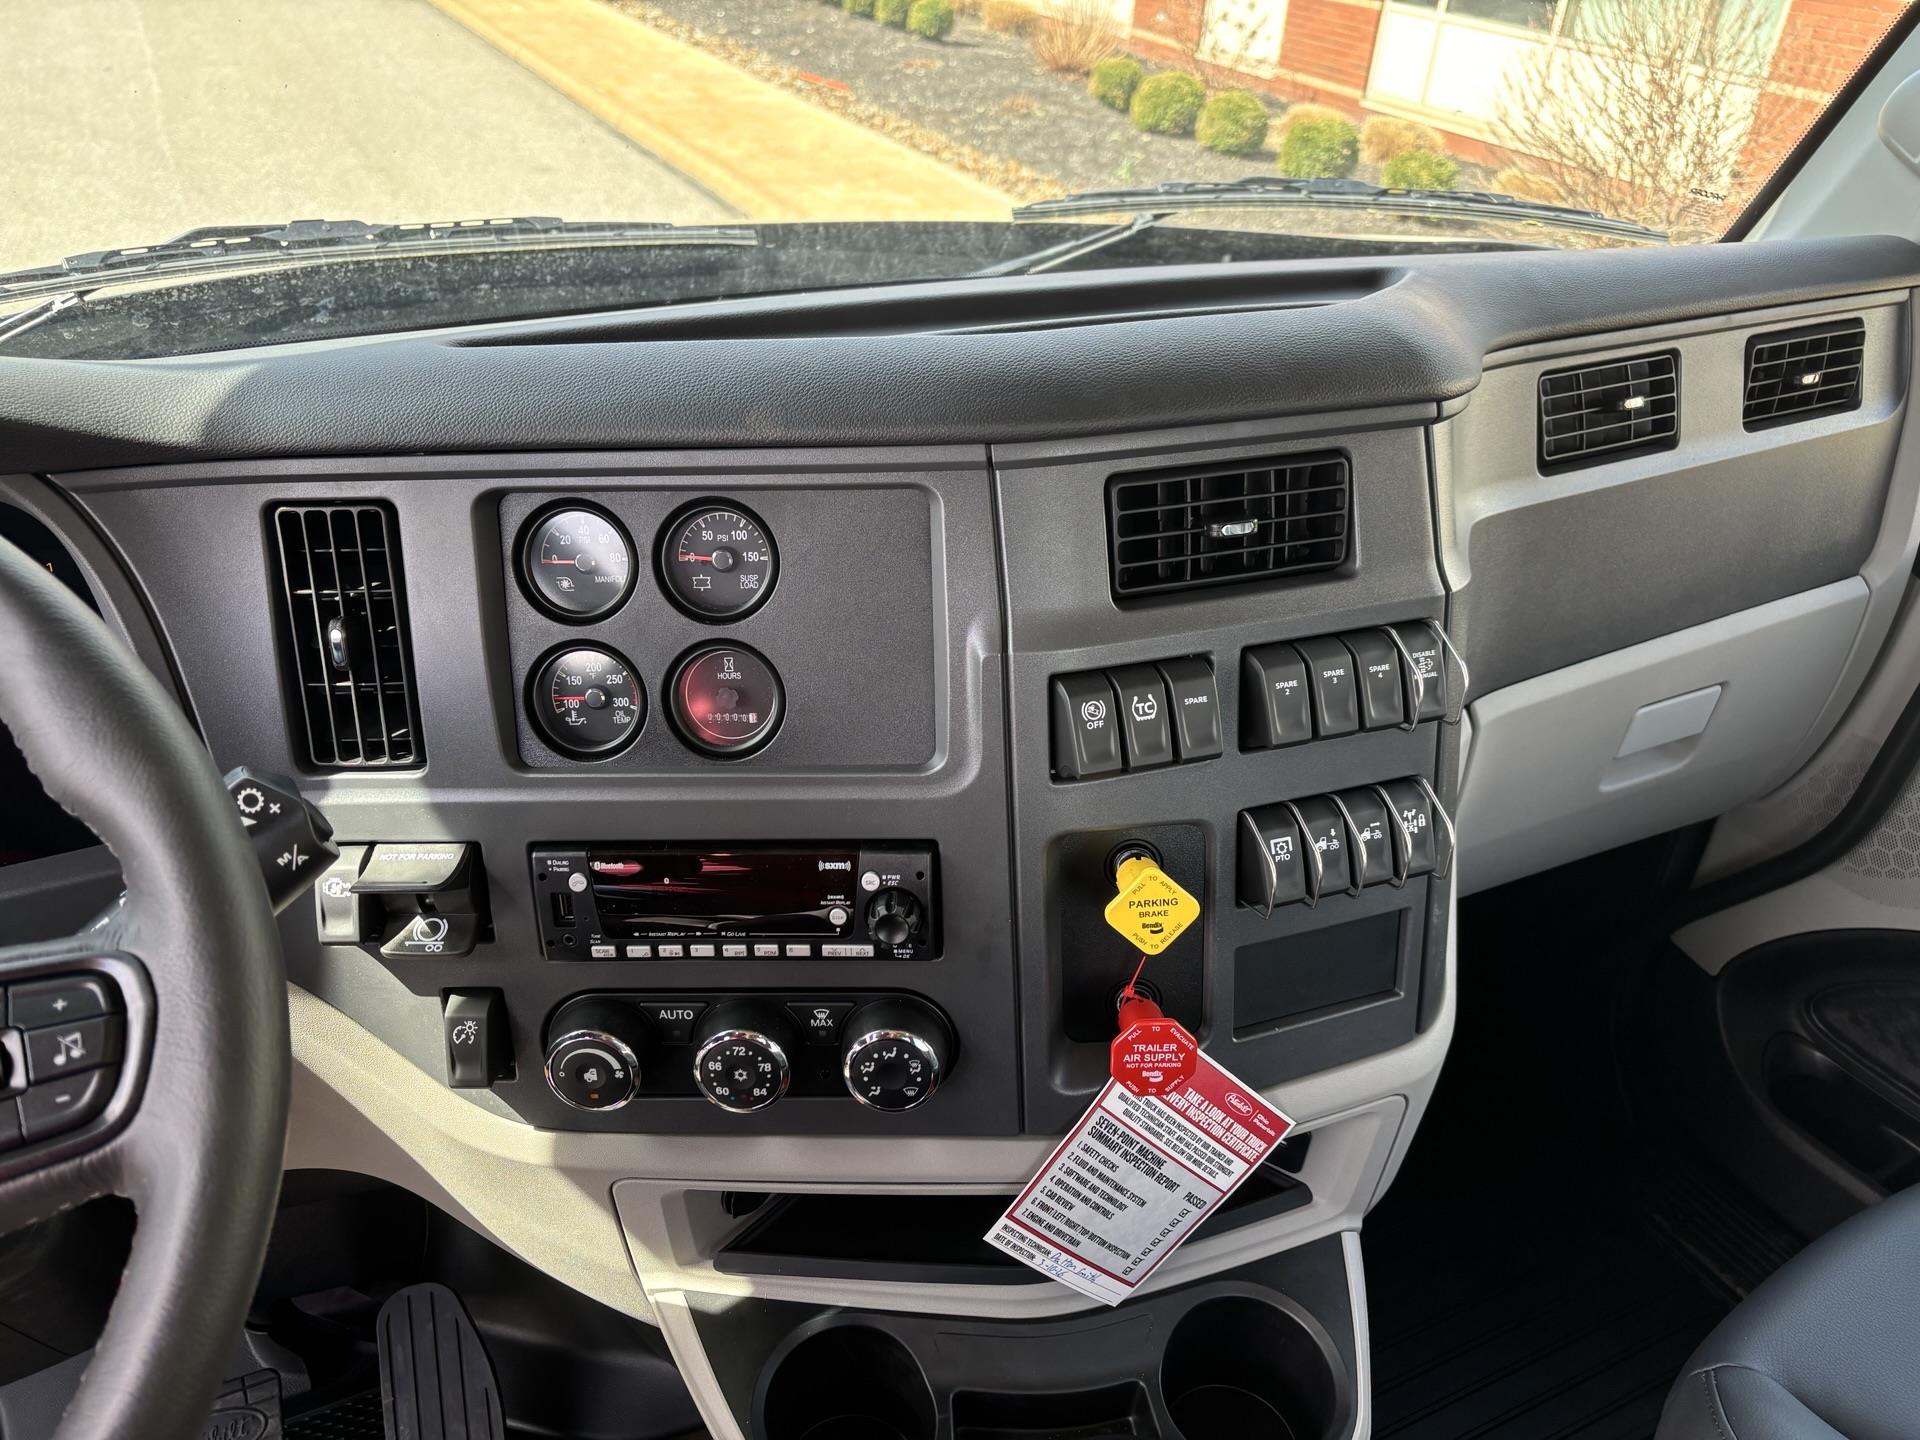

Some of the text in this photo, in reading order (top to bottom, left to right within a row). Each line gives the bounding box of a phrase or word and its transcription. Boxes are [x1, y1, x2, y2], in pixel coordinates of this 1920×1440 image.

[560, 535, 571, 544] 20
[702, 531, 713, 541] 50
[717, 534, 728, 542] PSI
[731, 530, 747, 540] 100
[742, 552, 759, 562] 150
[594, 575, 626, 583] MANIFOL
[740, 581, 758, 589] LOAD
[1412, 650, 1436, 659] DISABLE
[585, 662, 601, 672] 200
[1369, 664, 1391, 673] SPARE
[717, 672, 742, 680] HOURS
[1323, 668, 1345, 678] SPARE
[1414, 672, 1438, 680] MNUAL
[566, 676, 582, 685] 150
[606, 675, 623, 684] 250
[1275, 680, 1299, 689] SPARE
[564, 700, 580, 708] 100
[612, 697, 629, 707] 300
[1184, 695, 1208, 705] SPARE
[1136, 701, 1154, 715] TC
[612, 716, 631, 724] TEMP
[1086, 720, 1105, 730] OFF
[380, 852, 454, 861] NOT FOR PARKING
[1275, 853, 1291, 863] PTO
[600, 862, 624, 870] Bluetooth
[1131, 882, 1146, 896] PULL
[1159, 880, 1177, 895] APPLY
[1128, 898, 1179, 909] PARKING
[1139, 910, 1169, 919] BRAKE
[1132, 932, 1147, 946] PUSH
[1160, 922, 1183, 945] RELEASE
[659, 1009, 694, 1020] AUTO
[810, 1019, 833, 1027] MAX
[1127, 1029, 1142, 1042] PULL
[1169, 1027, 1195, 1051] EVACUATE
[732, 1047, 746, 1056] 72
[1133, 1043, 1177, 1052] TRAILER
[1123, 1053, 1186, 1063] AIR SUPPLY
[708, 1061, 722, 1071] 66
[758, 1063, 772, 1072] 78
[1126, 1080, 1140, 1093] PUSH
[1165, 1075, 1184, 1092] SUPPLY
[716, 1087, 730, 1096] 60
[753, 1088, 767, 1096] 84
[1118, 1092, 1141, 1112] QUALIFIED
[1139, 1108, 1165, 1129] TECHNICIAN
[1142, 1098, 1158, 1112] TRUCK
[1156, 1108, 1166, 1118] HAS
[1164, 1114, 1177, 1126] BEEN
[1123, 1108, 1142, 1124] QUALITY
[1184, 1087, 1268, 1153] TAKE A LOOK AT YOUR TRUCK
[1185, 1105, 1226, 1138] INSPECTION
[1221, 1132, 1259, 1162] CERTIFICATE
[1096, 1116, 1167, 1170] SEVEN-POINT MACHINE
[1081, 1144, 1101, 1160] SAFETY
[1098, 1156, 1119, 1172] CHECKS
[1088, 1126, 1180, 1192] SUMMARY INSPECTION REPORT
[1067, 1152, 1147, 1207] 2. FLUID AND MAINTENANCE SYSTEM
[1058, 1163, 1128, 1212] 3. SOFTWARE AND TECHNOLOGY
[1040, 1186, 1075, 1211] 5. CAB REVIEW
[1054, 1178, 1082, 1199] OPERATION
[1080, 1195, 1092, 1205] AND
[1089, 1201, 1114, 1220] CONTROLS
[1183, 1192, 1207, 1209] PASSED
[1001, 1224, 1028, 1243] INSPECTING
[1026, 1211, 1046, 1227] ENGINE
[1043, 1222, 1055, 1232] AND
[1053, 1228, 1081, 1247] DRIVETRAIN
[994, 1233, 1007, 1243] DATE
[1105, 1243, 1131, 1260] INSPECTION
